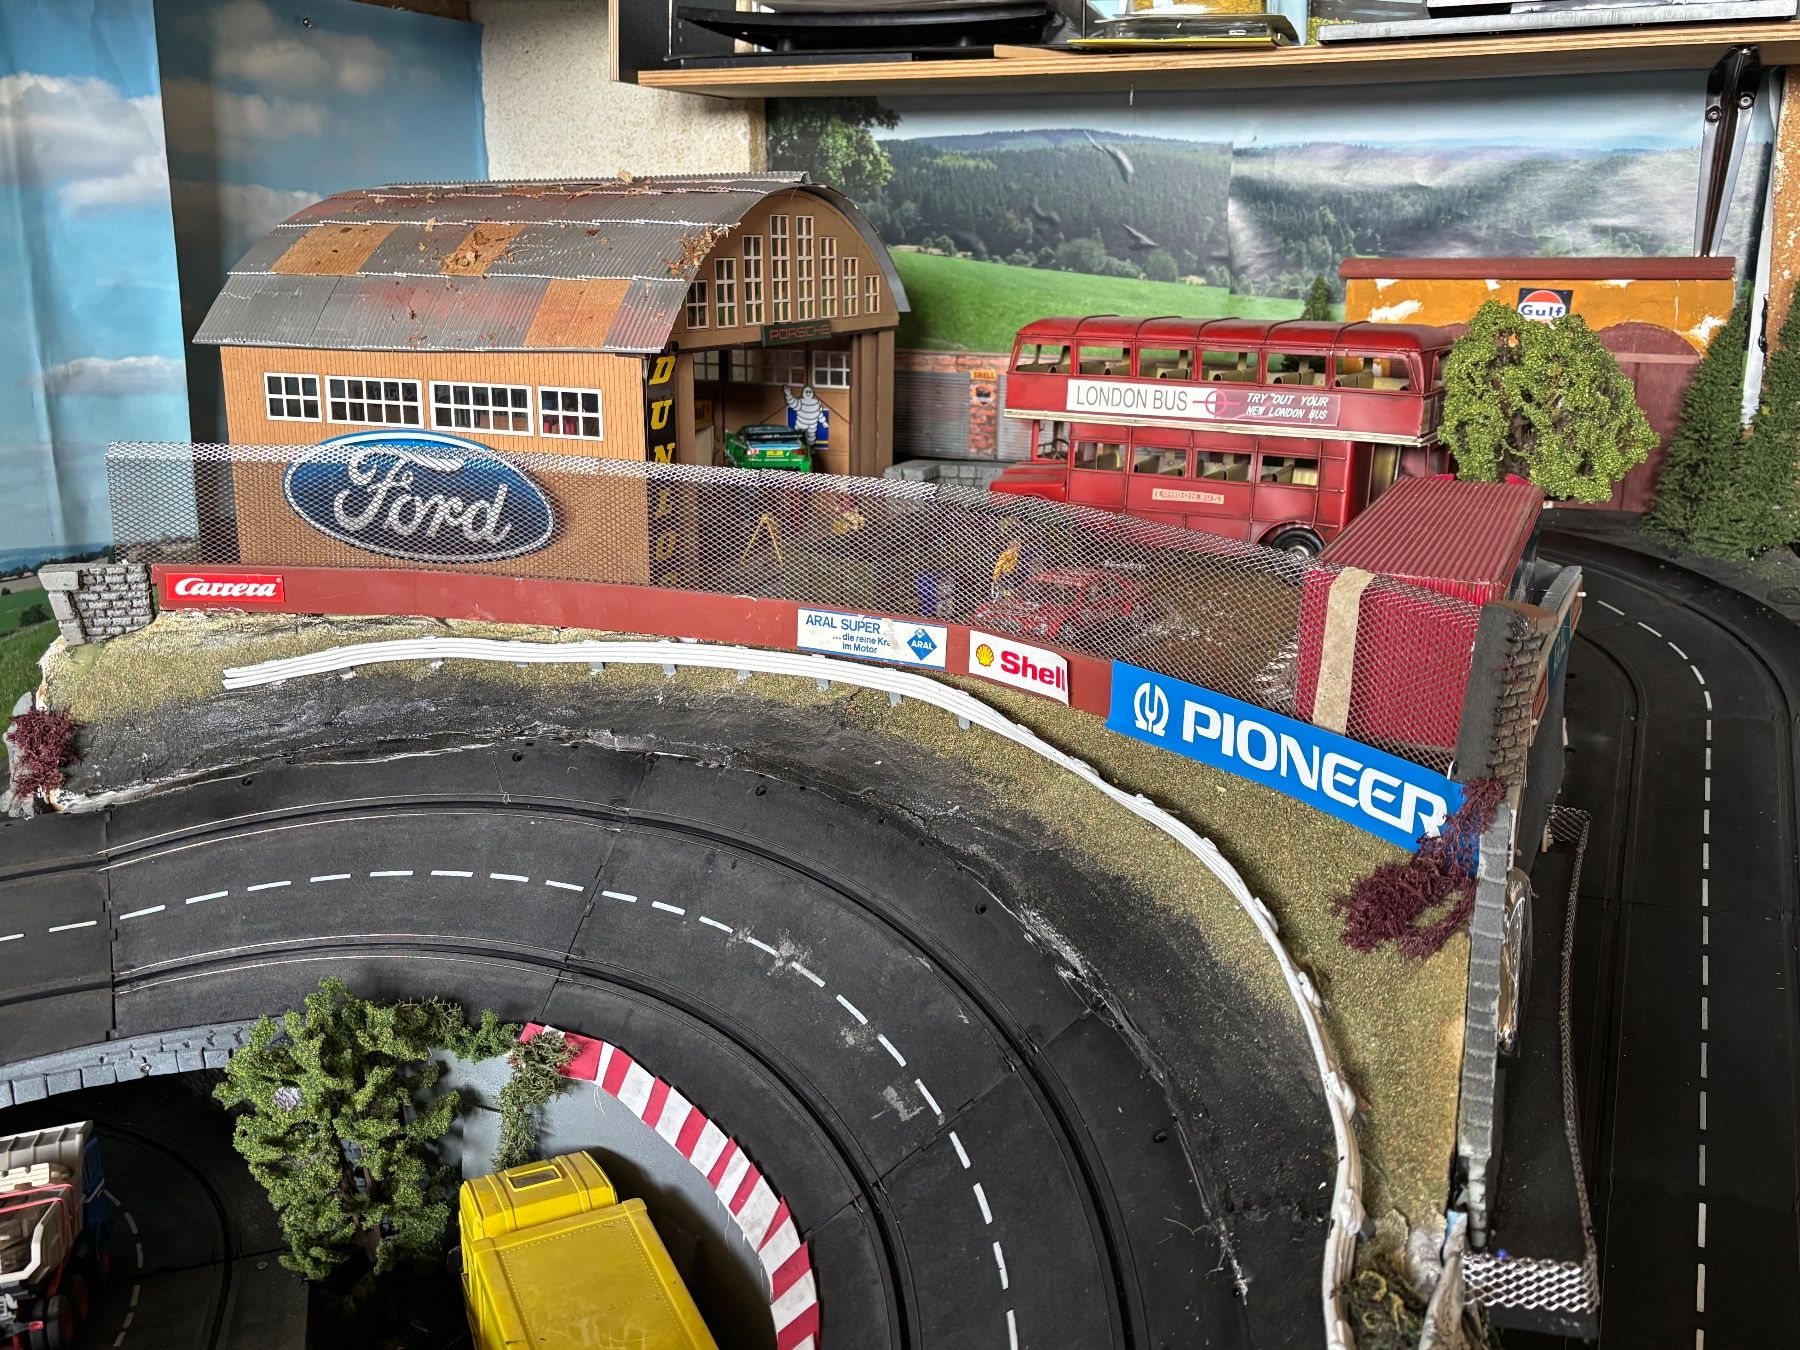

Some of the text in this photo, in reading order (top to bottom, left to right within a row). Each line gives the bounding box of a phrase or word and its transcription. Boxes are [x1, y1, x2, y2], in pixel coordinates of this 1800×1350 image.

[1520, 304, 1563, 317] Gulf
[769, 324, 831, 340] PORSCHE
[1076, 385, 1188, 411] LONDON BUS
[1247, 393, 1268, 403] TRY
[1300, 395, 1329, 407] YOUR
[1246, 406, 1328, 419] NEW LONDON BUS
[334, 445, 512, 544] Ford
[175, 577, 277, 597] Carrera
[806, 614, 880, 634] ARAL SUPER
[842, 642, 877, 654] im Motor
[856, 635, 876, 645] reine
[911, 639, 933, 650] ARAL
[1000, 650, 1066, 692] Shell
[1182, 699, 1448, 838] PIONEER
